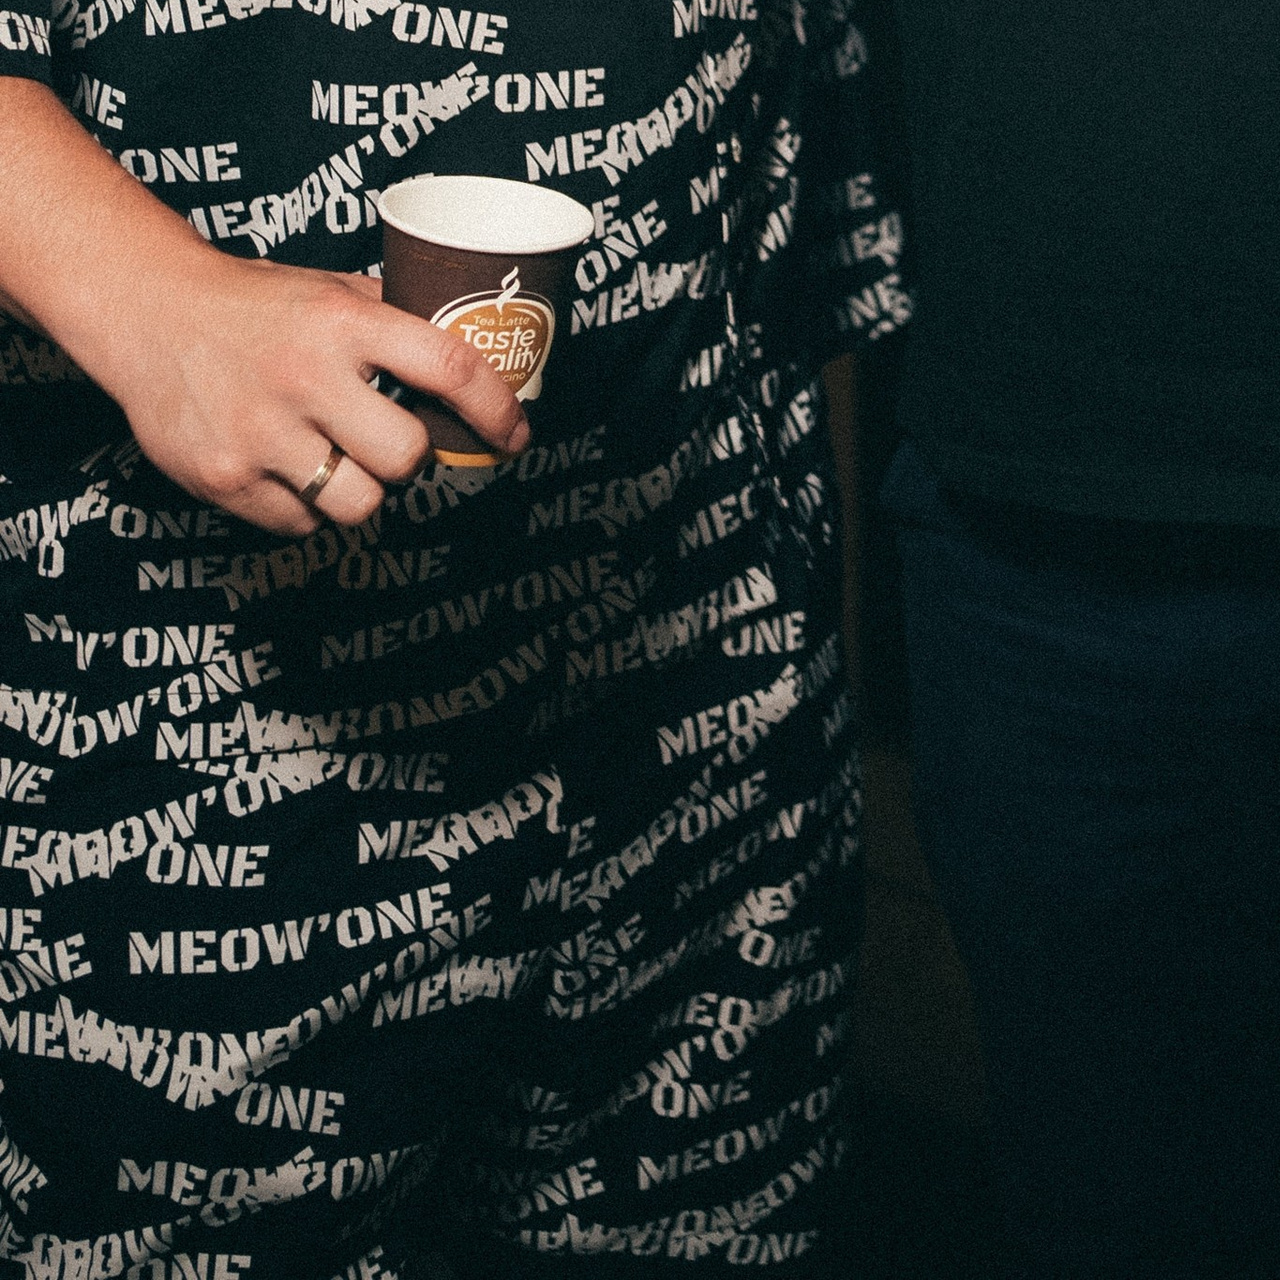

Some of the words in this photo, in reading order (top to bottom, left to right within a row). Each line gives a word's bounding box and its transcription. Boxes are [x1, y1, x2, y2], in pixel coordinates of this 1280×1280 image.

[473, 315, 495, 326] Tea
[459, 324, 536, 350] Taste
[483, 347, 541, 372] ality
[128, 884, 450, 974] MEOW'ONE
